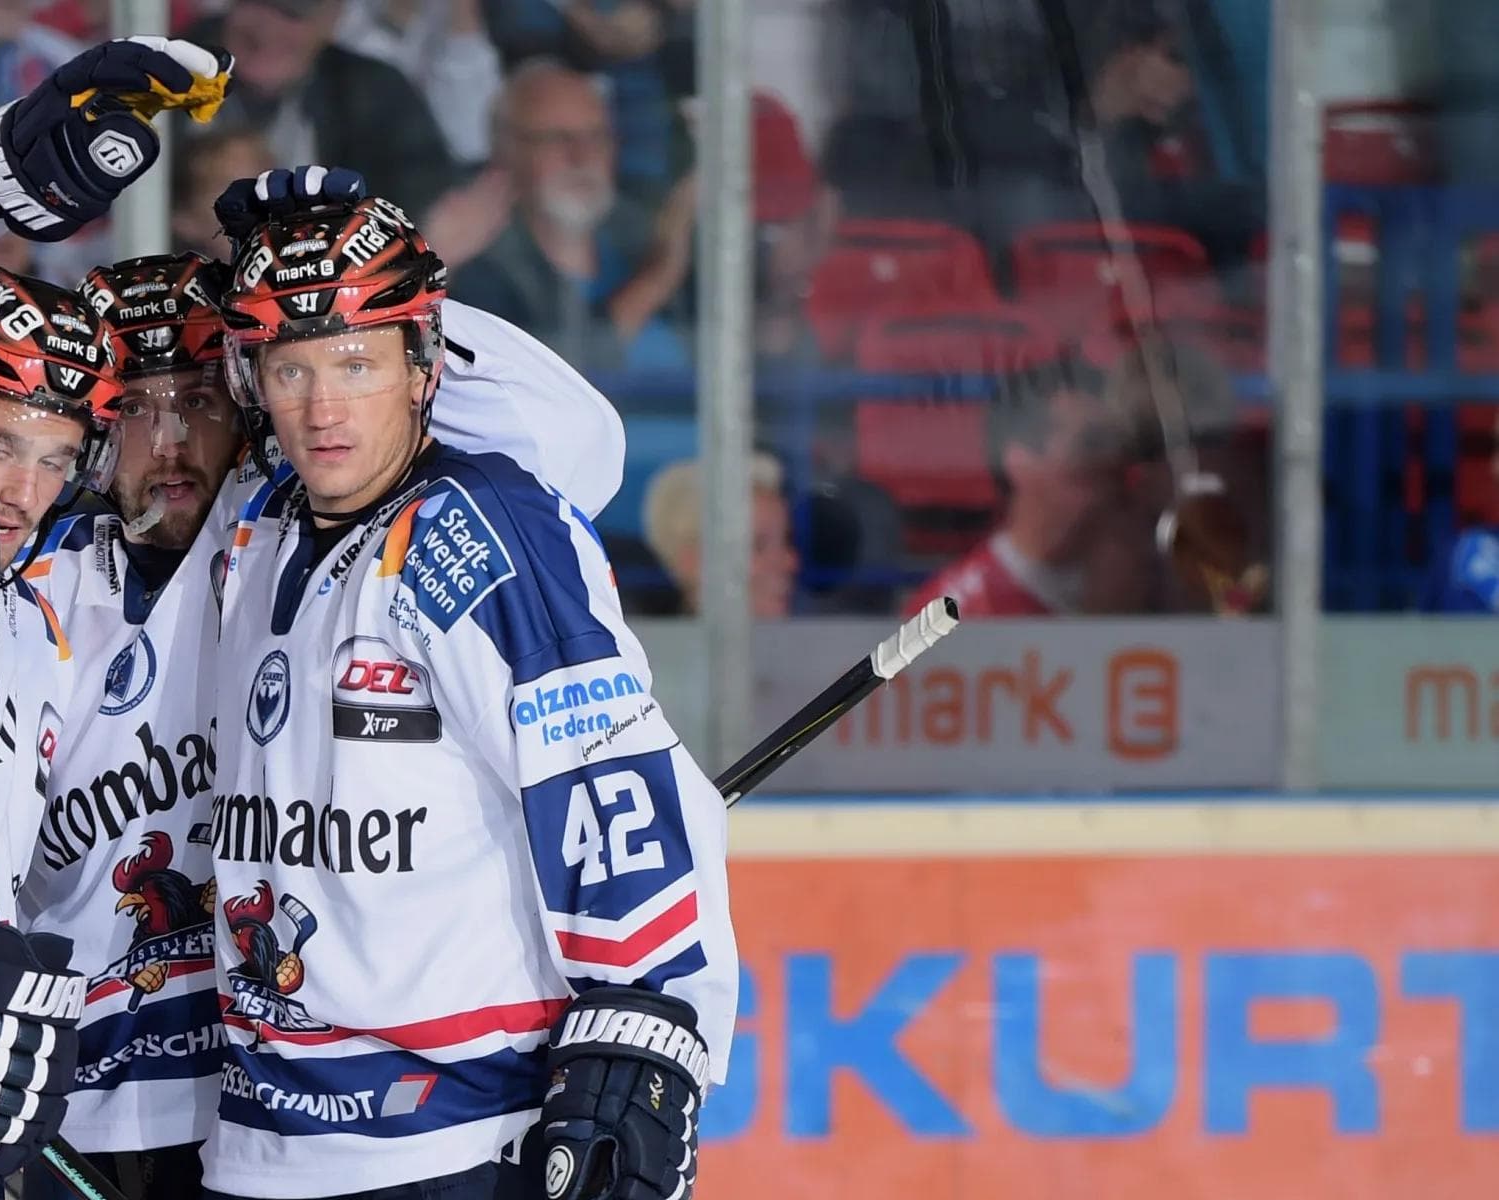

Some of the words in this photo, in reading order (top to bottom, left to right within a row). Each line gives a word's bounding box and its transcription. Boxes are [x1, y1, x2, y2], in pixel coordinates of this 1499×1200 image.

[275, 262, 318, 283] mark
[119, 302, 161, 320] mark
[46, 335, 85, 356] mark
[438, 507, 492, 572] Stadt-
[404, 543, 457, 614] Iserlohn
[422, 526, 476, 595] werke
[337, 659, 415, 695] DEL
[542, 712, 612, 746] federn
[581, 737, 603, 762] form
[604, 715, 638, 745] follows
[561, 769, 666, 887] 42
